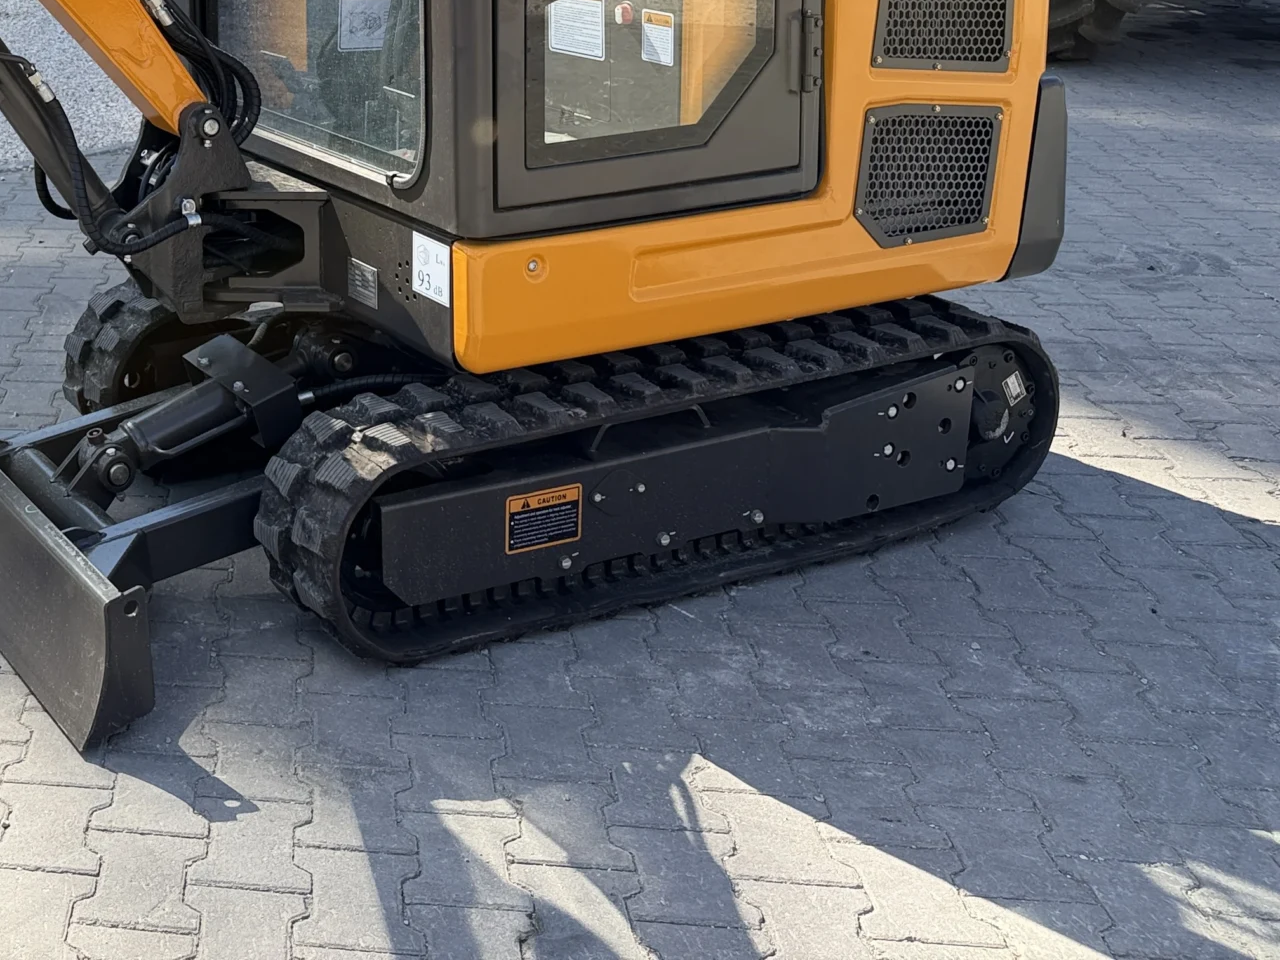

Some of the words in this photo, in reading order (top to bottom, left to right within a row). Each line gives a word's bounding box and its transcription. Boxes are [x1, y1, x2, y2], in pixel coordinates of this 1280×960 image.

[418, 269, 431, 291] 93
[433, 285, 443, 297] dB
[537, 493, 567, 504] CAUTION
